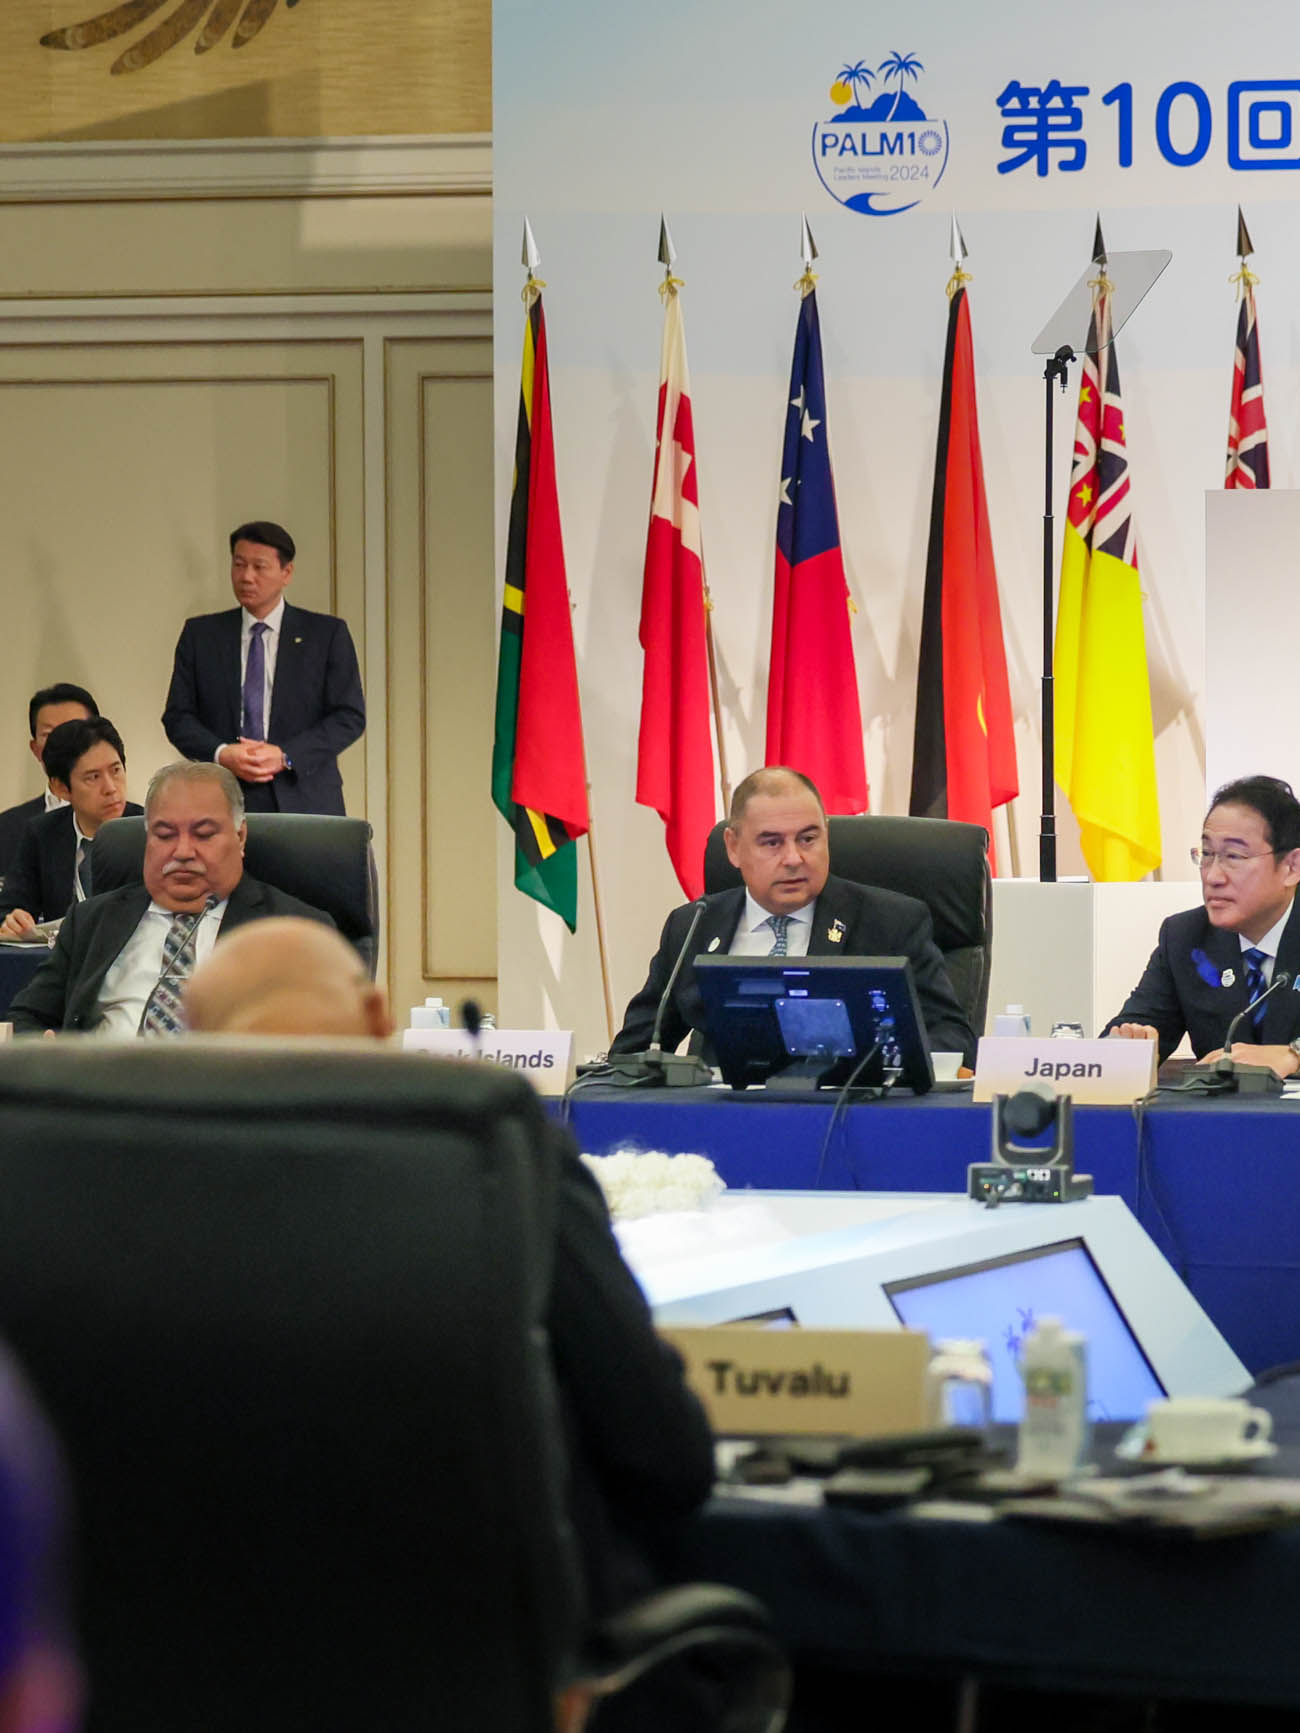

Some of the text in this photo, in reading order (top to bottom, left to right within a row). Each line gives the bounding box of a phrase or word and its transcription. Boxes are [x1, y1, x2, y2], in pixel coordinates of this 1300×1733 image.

[821, 130, 943, 157] PALM10
[889, 165, 930, 181] 2024
[1025, 1058, 1102, 1081] Japan
[707, 1360, 851, 1400] Tuvalu
